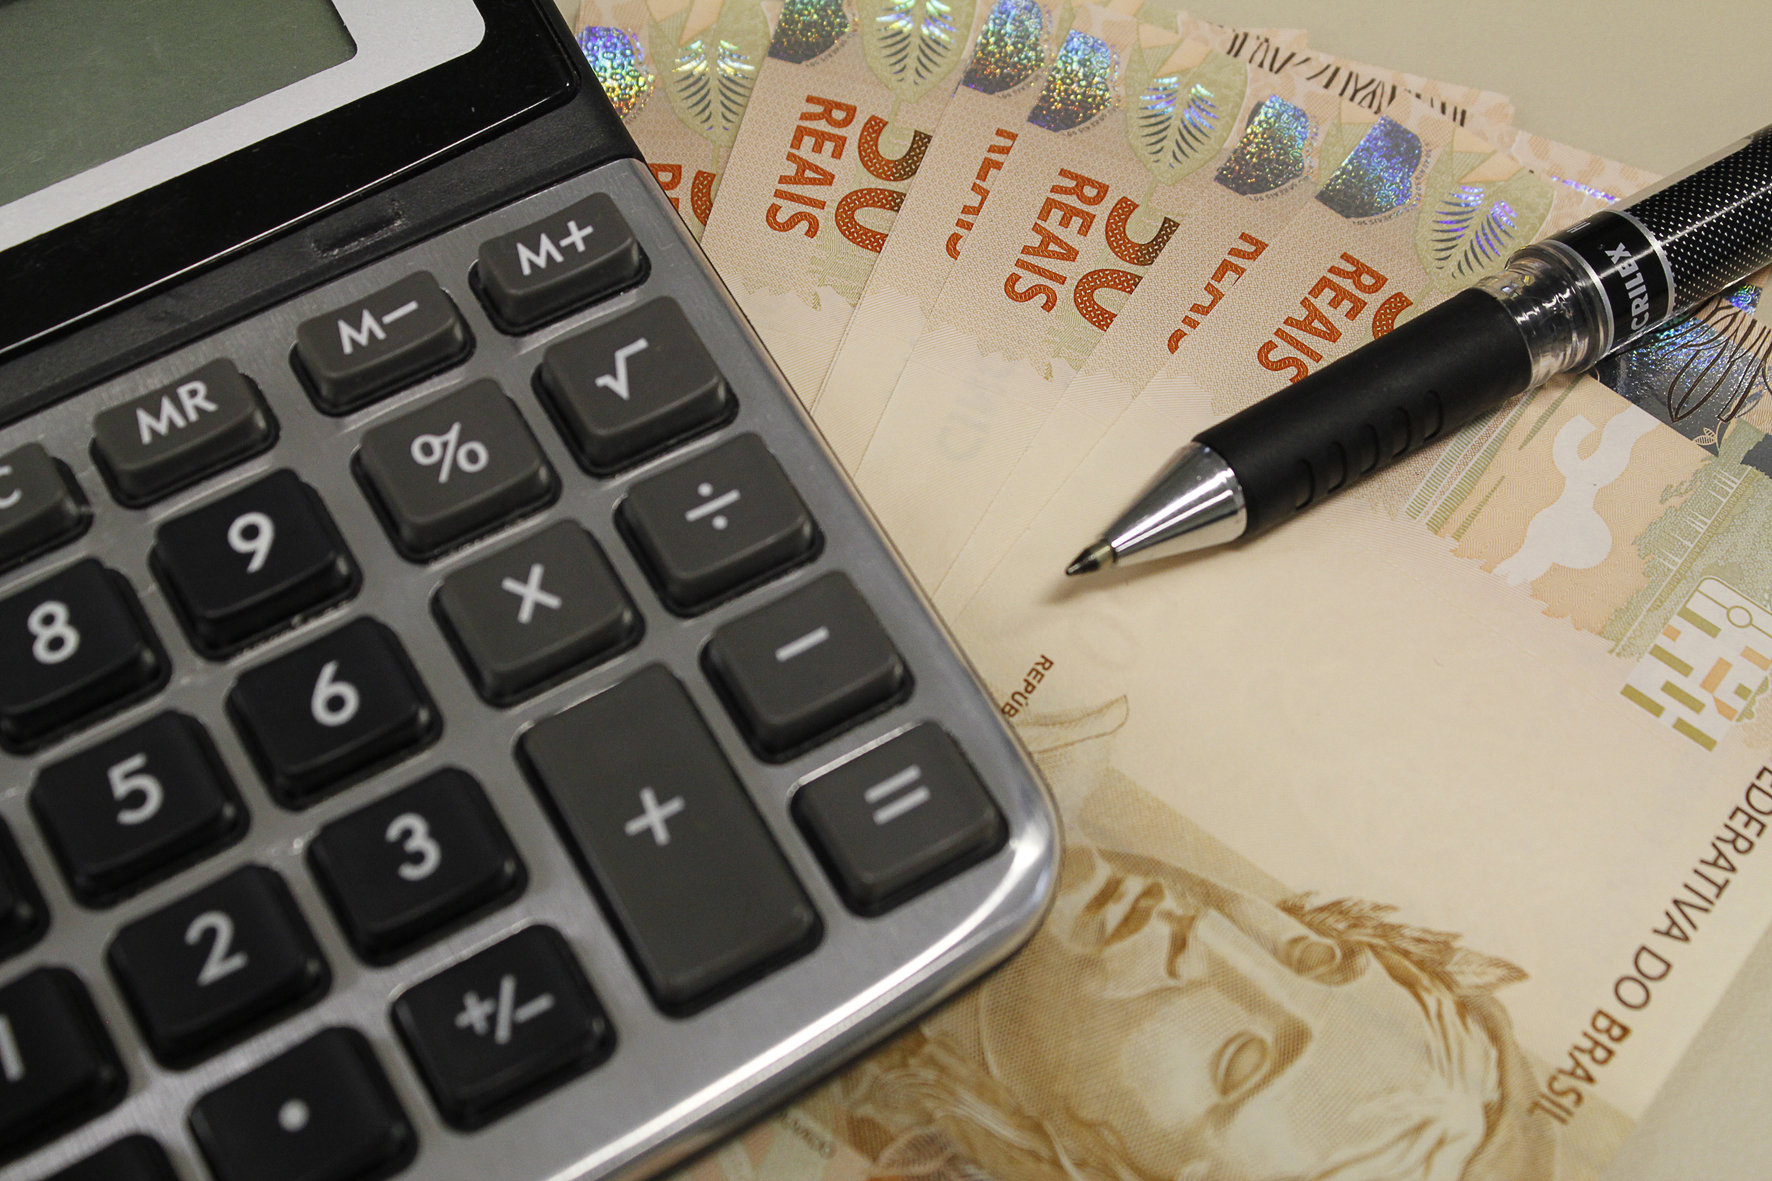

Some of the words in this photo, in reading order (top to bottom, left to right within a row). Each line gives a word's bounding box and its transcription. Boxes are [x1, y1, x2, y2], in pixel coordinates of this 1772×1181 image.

[766, 94, 857, 239] REAIS
[516, 220, 594, 276] M+
[1004, 168, 1110, 313] REAIS
[1257, 252, 1388, 384] REAIS
[135, 379, 217, 444] MR
[410, 422, 488, 483] %
[227, 512, 274, 573] 9
[27, 601, 79, 664] 8
[311, 660, 360, 727] 6
[107, 753, 163, 825] 5
[385, 813, 442, 881] 3
[185, 911, 248, 986] 2
[1613, 945, 1673, 1011] DO
[1527, 1009, 1632, 1126] BRASIL
